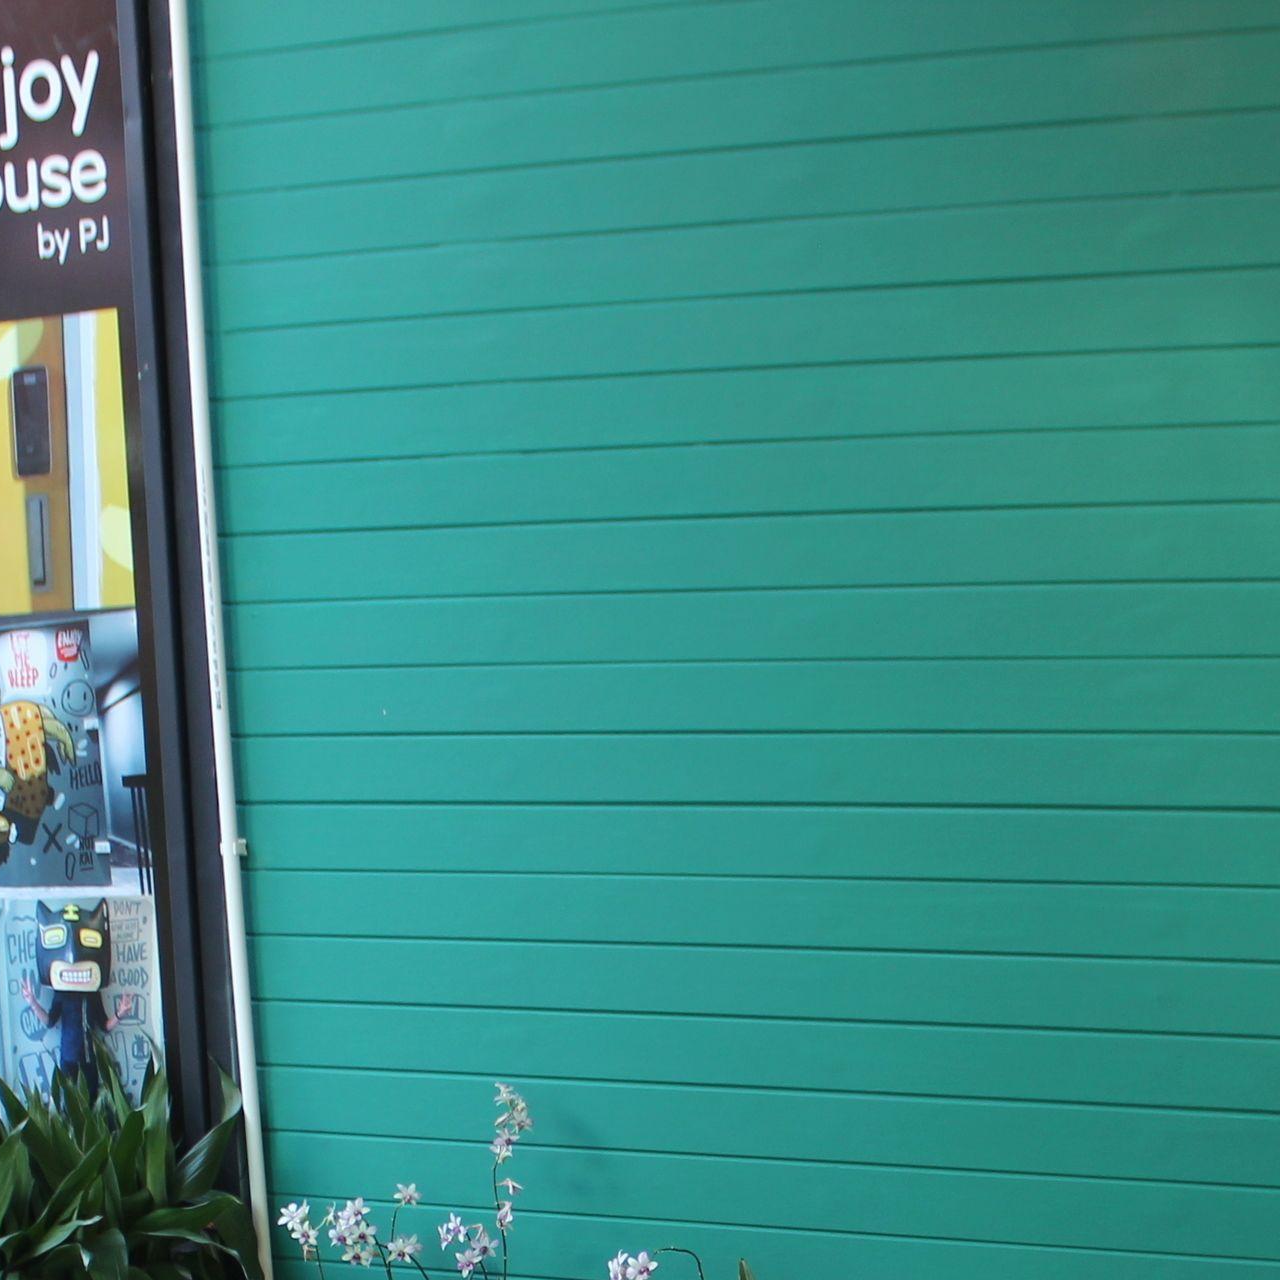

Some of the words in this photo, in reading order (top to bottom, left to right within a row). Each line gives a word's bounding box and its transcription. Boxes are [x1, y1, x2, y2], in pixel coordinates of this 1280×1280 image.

[37, 222, 70, 265] by
[79, 215, 110, 254] PJ
[70, 762, 103, 789] HELLO
[116, 942, 148, 963] HAVE
[119, 966, 149, 987] GOOD
